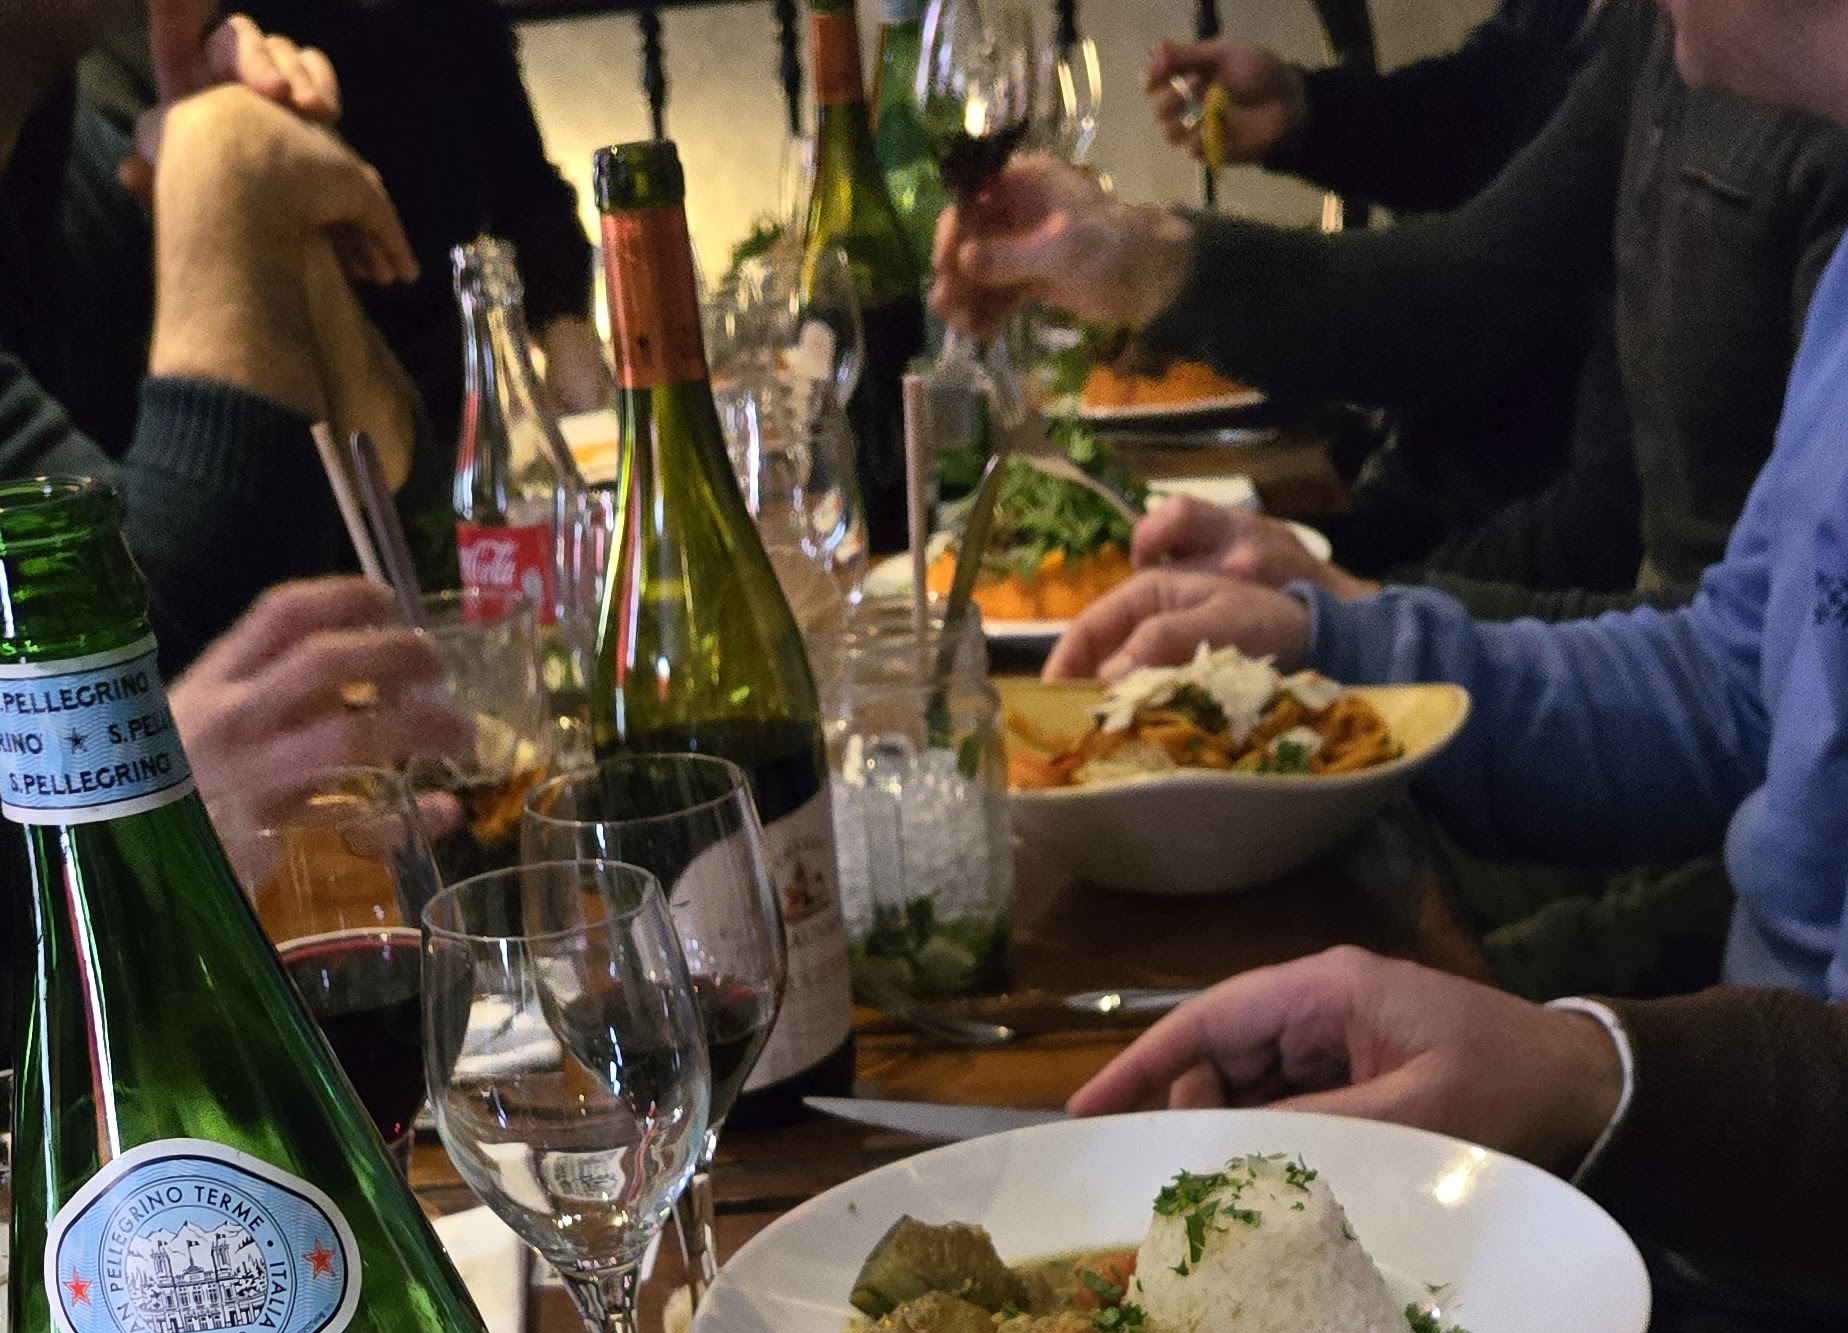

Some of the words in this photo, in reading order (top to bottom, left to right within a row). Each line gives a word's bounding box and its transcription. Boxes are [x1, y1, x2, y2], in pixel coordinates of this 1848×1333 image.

[9, 751, 171, 796] S.PELLEGRINO
[107, 1187, 183, 1293] PELLEGRINO
[194, 1185, 265, 1232] TERME
[259, 1261, 287, 1330] ITALIA
